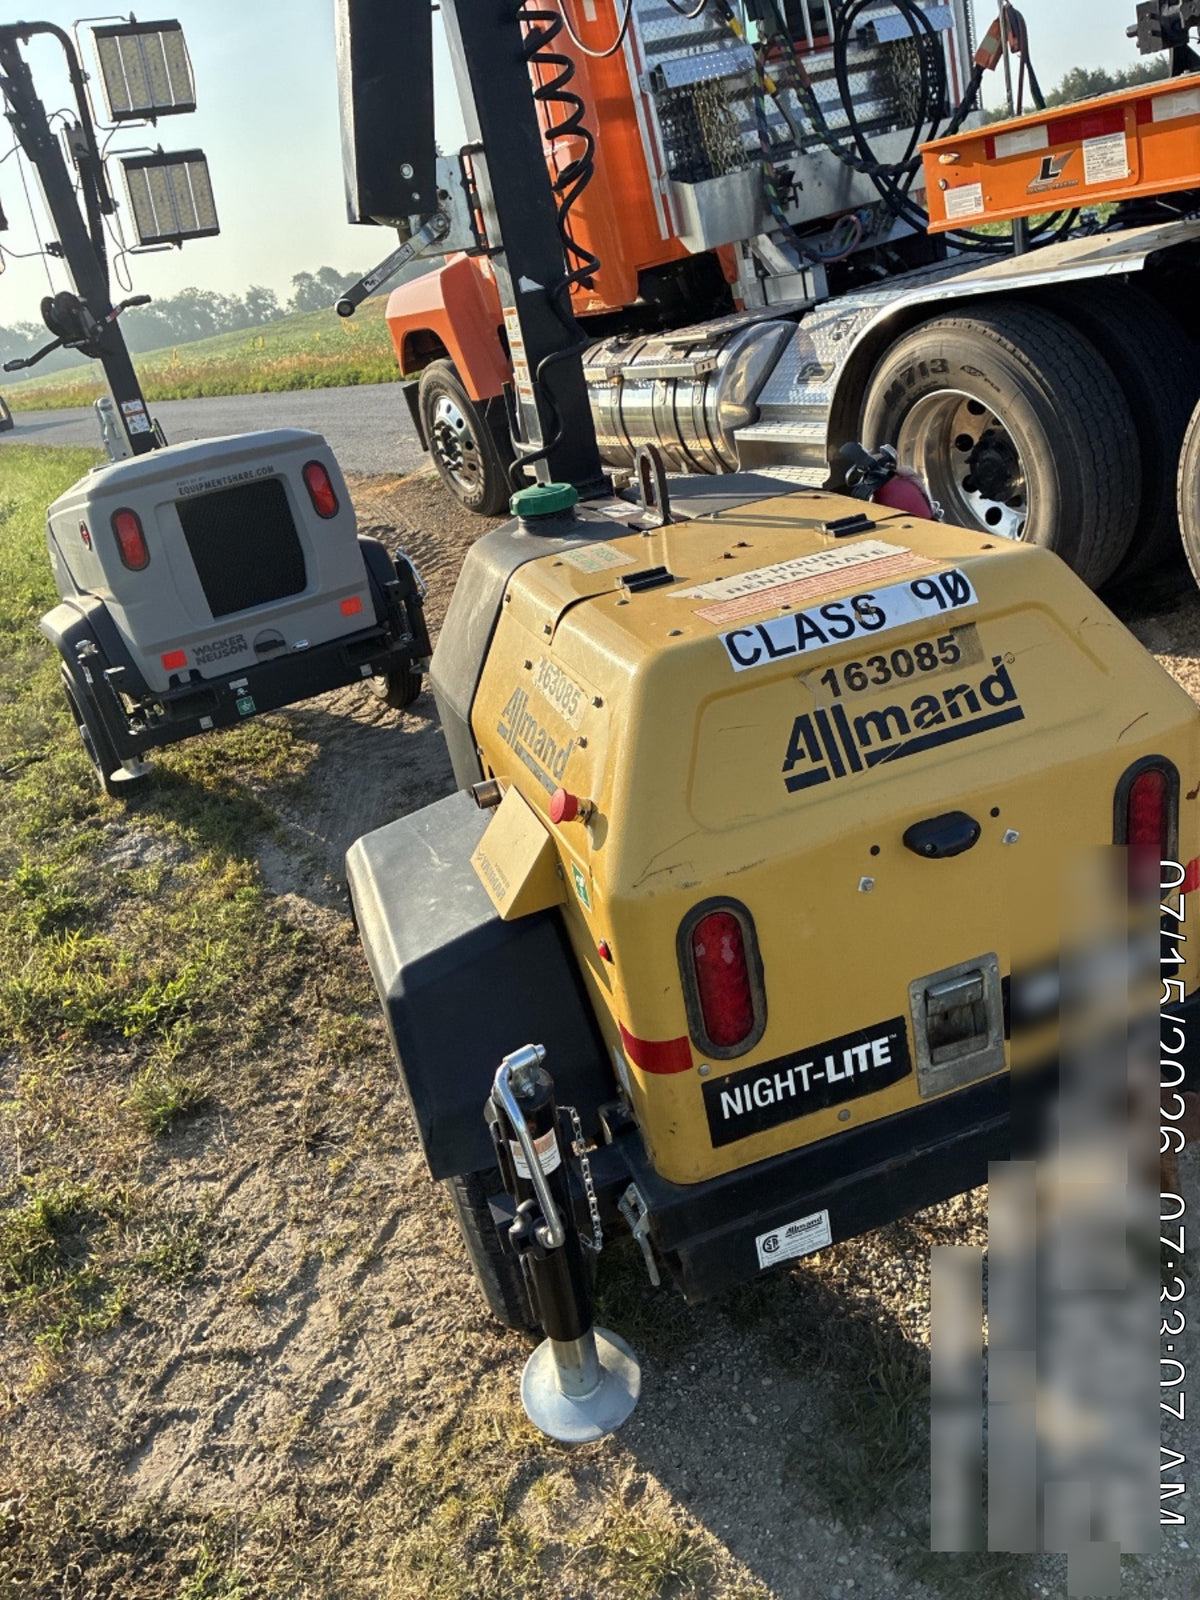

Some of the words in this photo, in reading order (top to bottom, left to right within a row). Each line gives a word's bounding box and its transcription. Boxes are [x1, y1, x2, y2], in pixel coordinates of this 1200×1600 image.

[178, 465, 275, 496] EQUIPMENTSHARE.COM
[726, 568, 822, 594] RENTAL
[825, 549, 886, 569] RATE
[192, 633, 246, 656] WACKER
[195, 642, 249, 667] NEUSON
[724, 593, 887, 667] CLASS
[537, 656, 582, 717] 163085
[820, 634, 961, 698] 163085
[501, 686, 575, 781] Allmand
